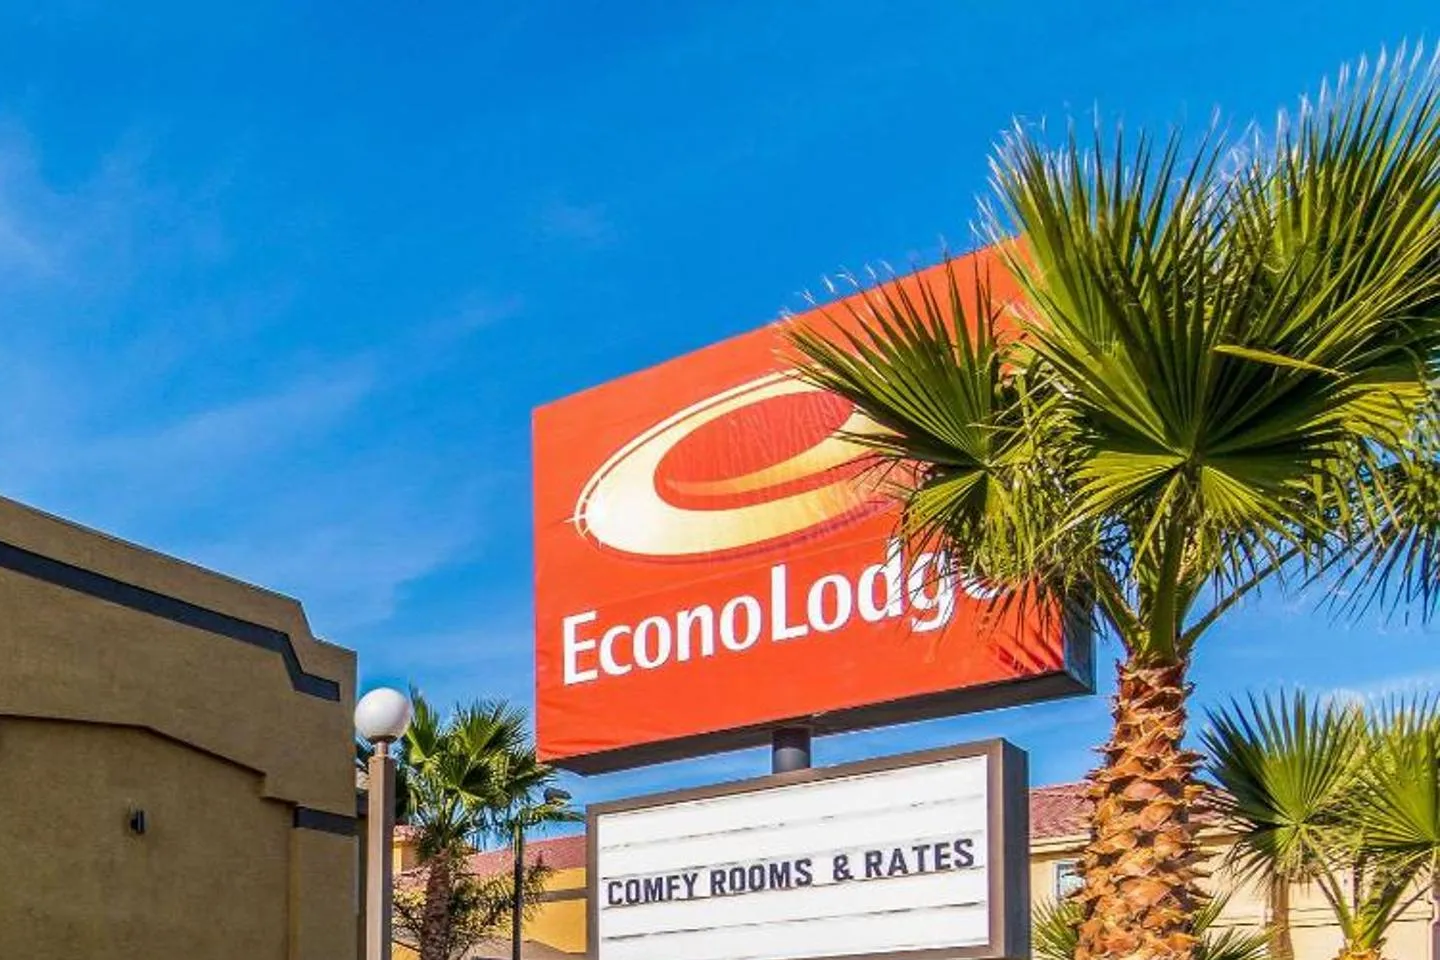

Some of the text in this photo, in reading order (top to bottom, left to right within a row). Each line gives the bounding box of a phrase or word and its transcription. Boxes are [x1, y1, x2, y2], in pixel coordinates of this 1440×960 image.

[562, 536, 1001, 686] EconoLodg
[607, 838, 975, 906] COMFY ROOMS & RATES
